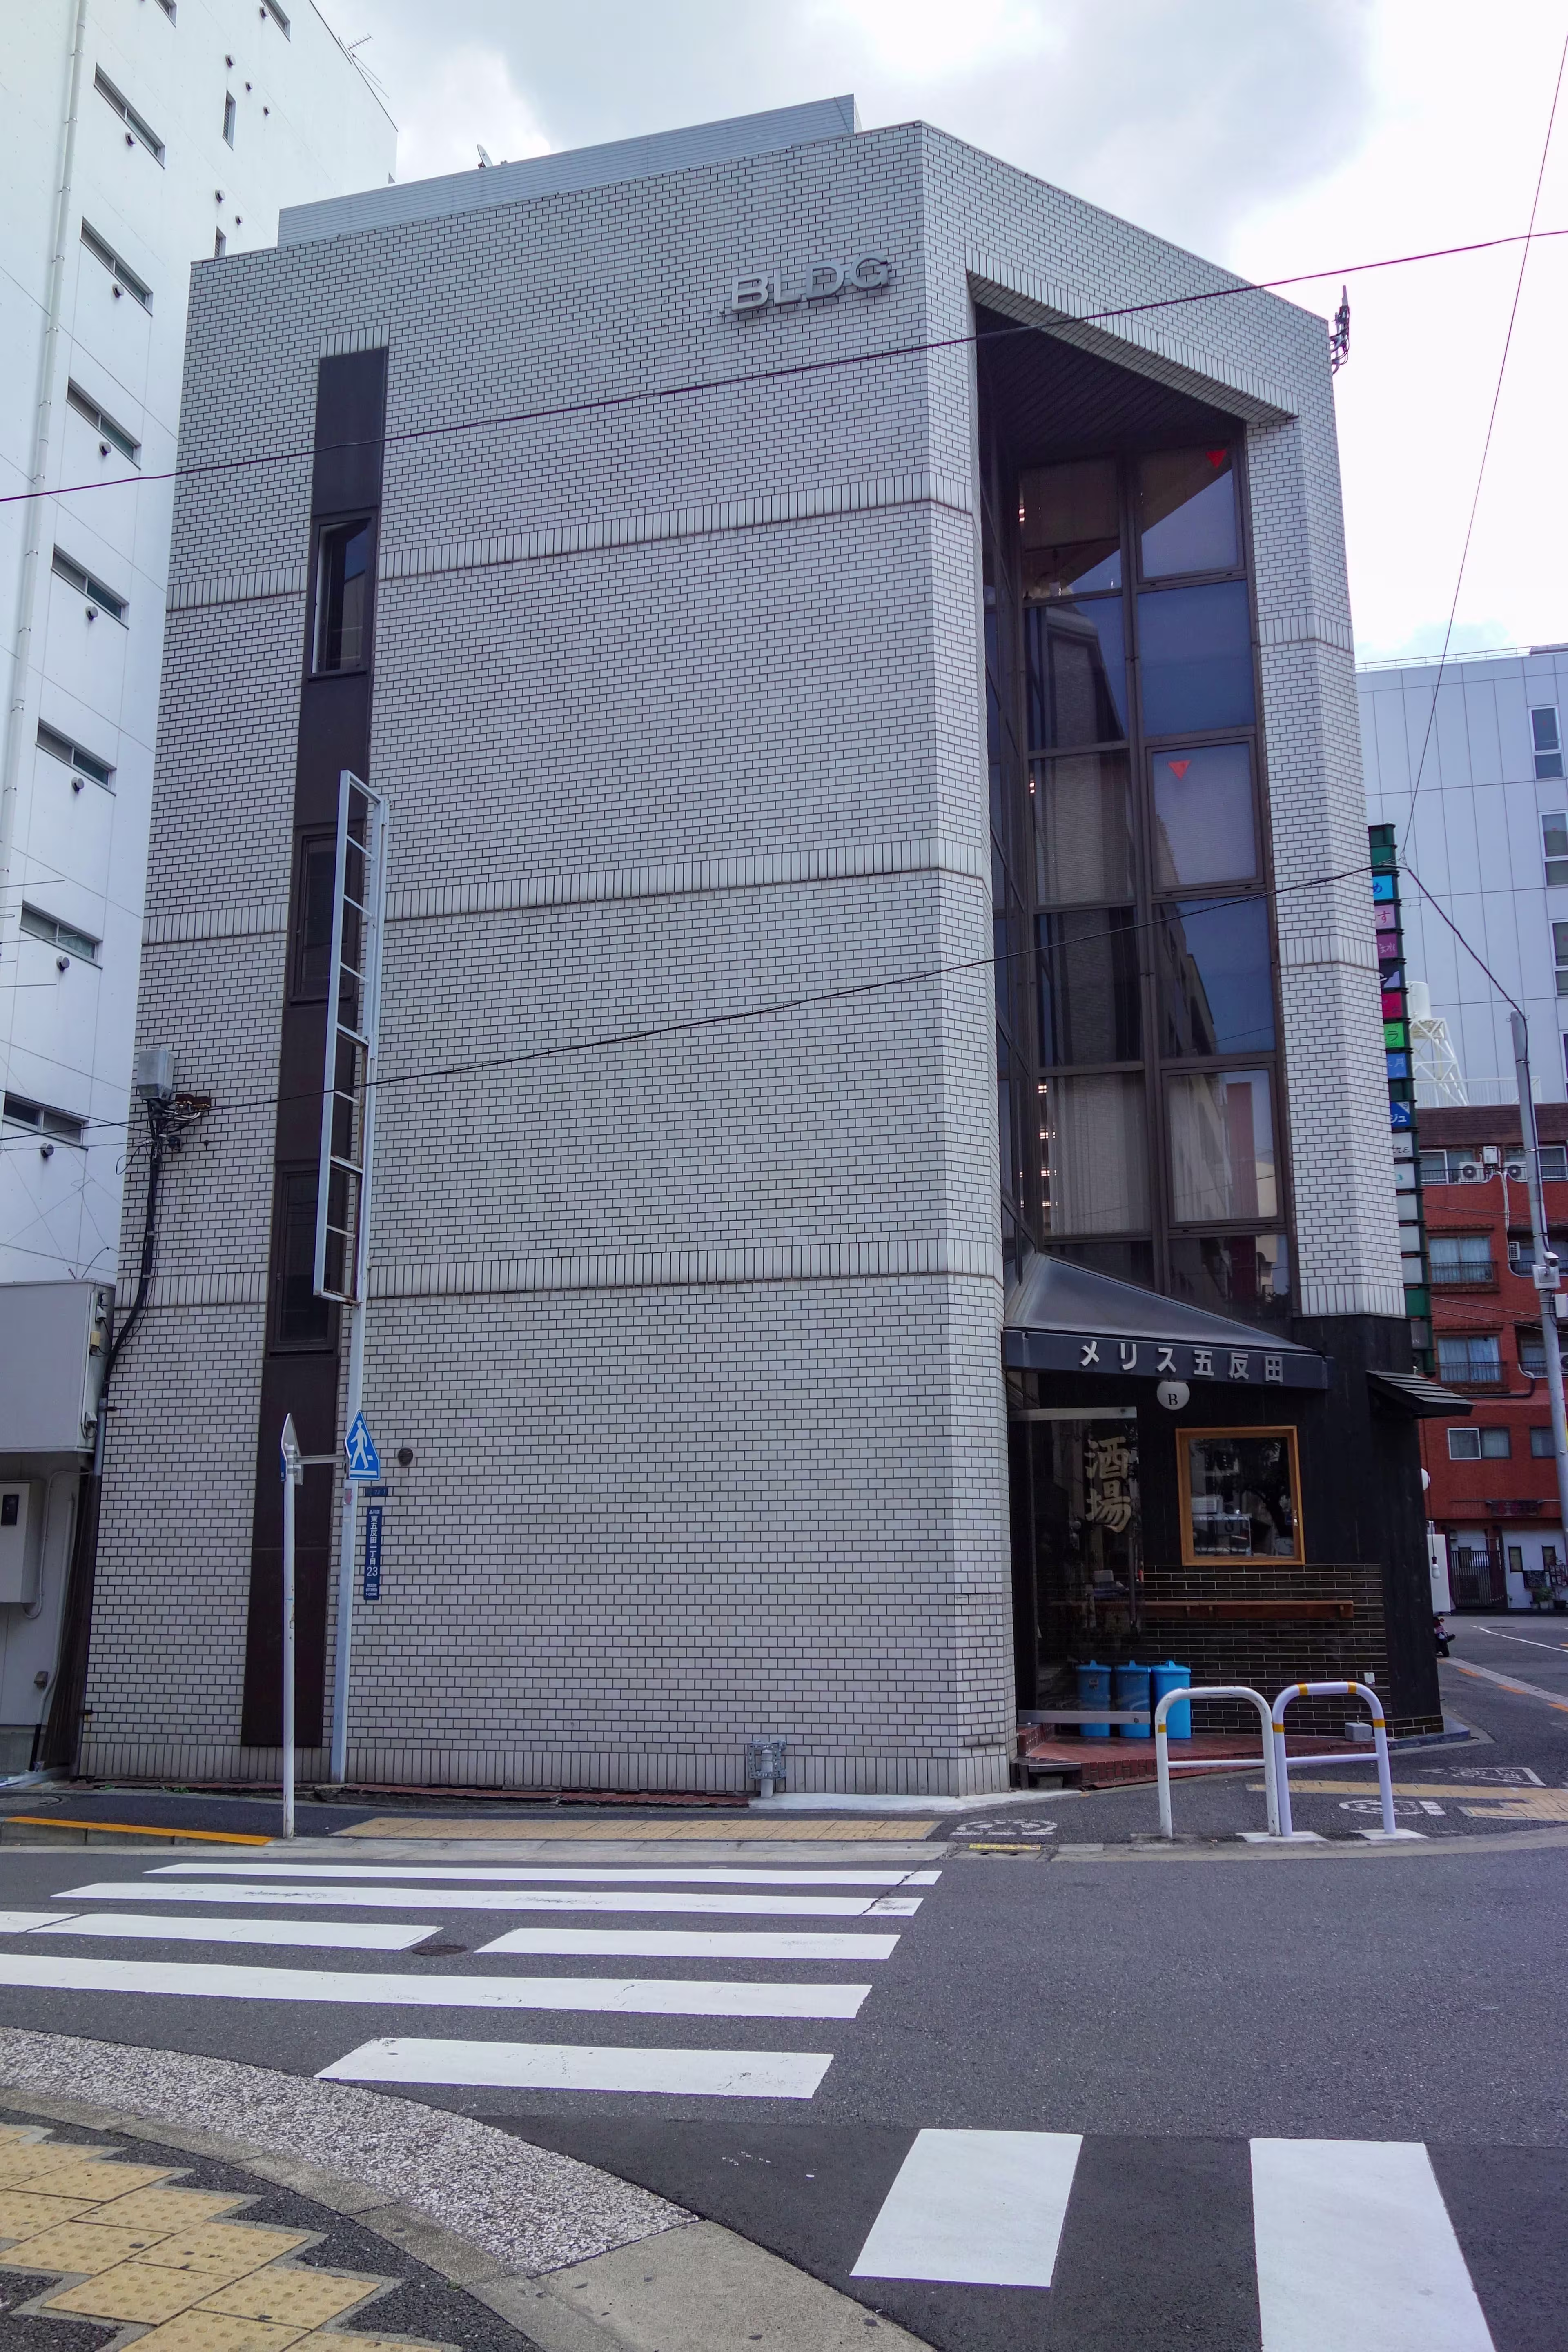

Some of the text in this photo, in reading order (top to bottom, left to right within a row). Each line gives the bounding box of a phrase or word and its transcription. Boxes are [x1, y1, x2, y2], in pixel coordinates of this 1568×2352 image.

[731, 252, 892, 313] BLDG
[1080, 1340, 1283, 1382] メリス五反田
[1168, 1393, 1178, 1406] B
[1084, 1436, 1131, 1533] 酒場
[367, 1566, 378, 1576] 23
